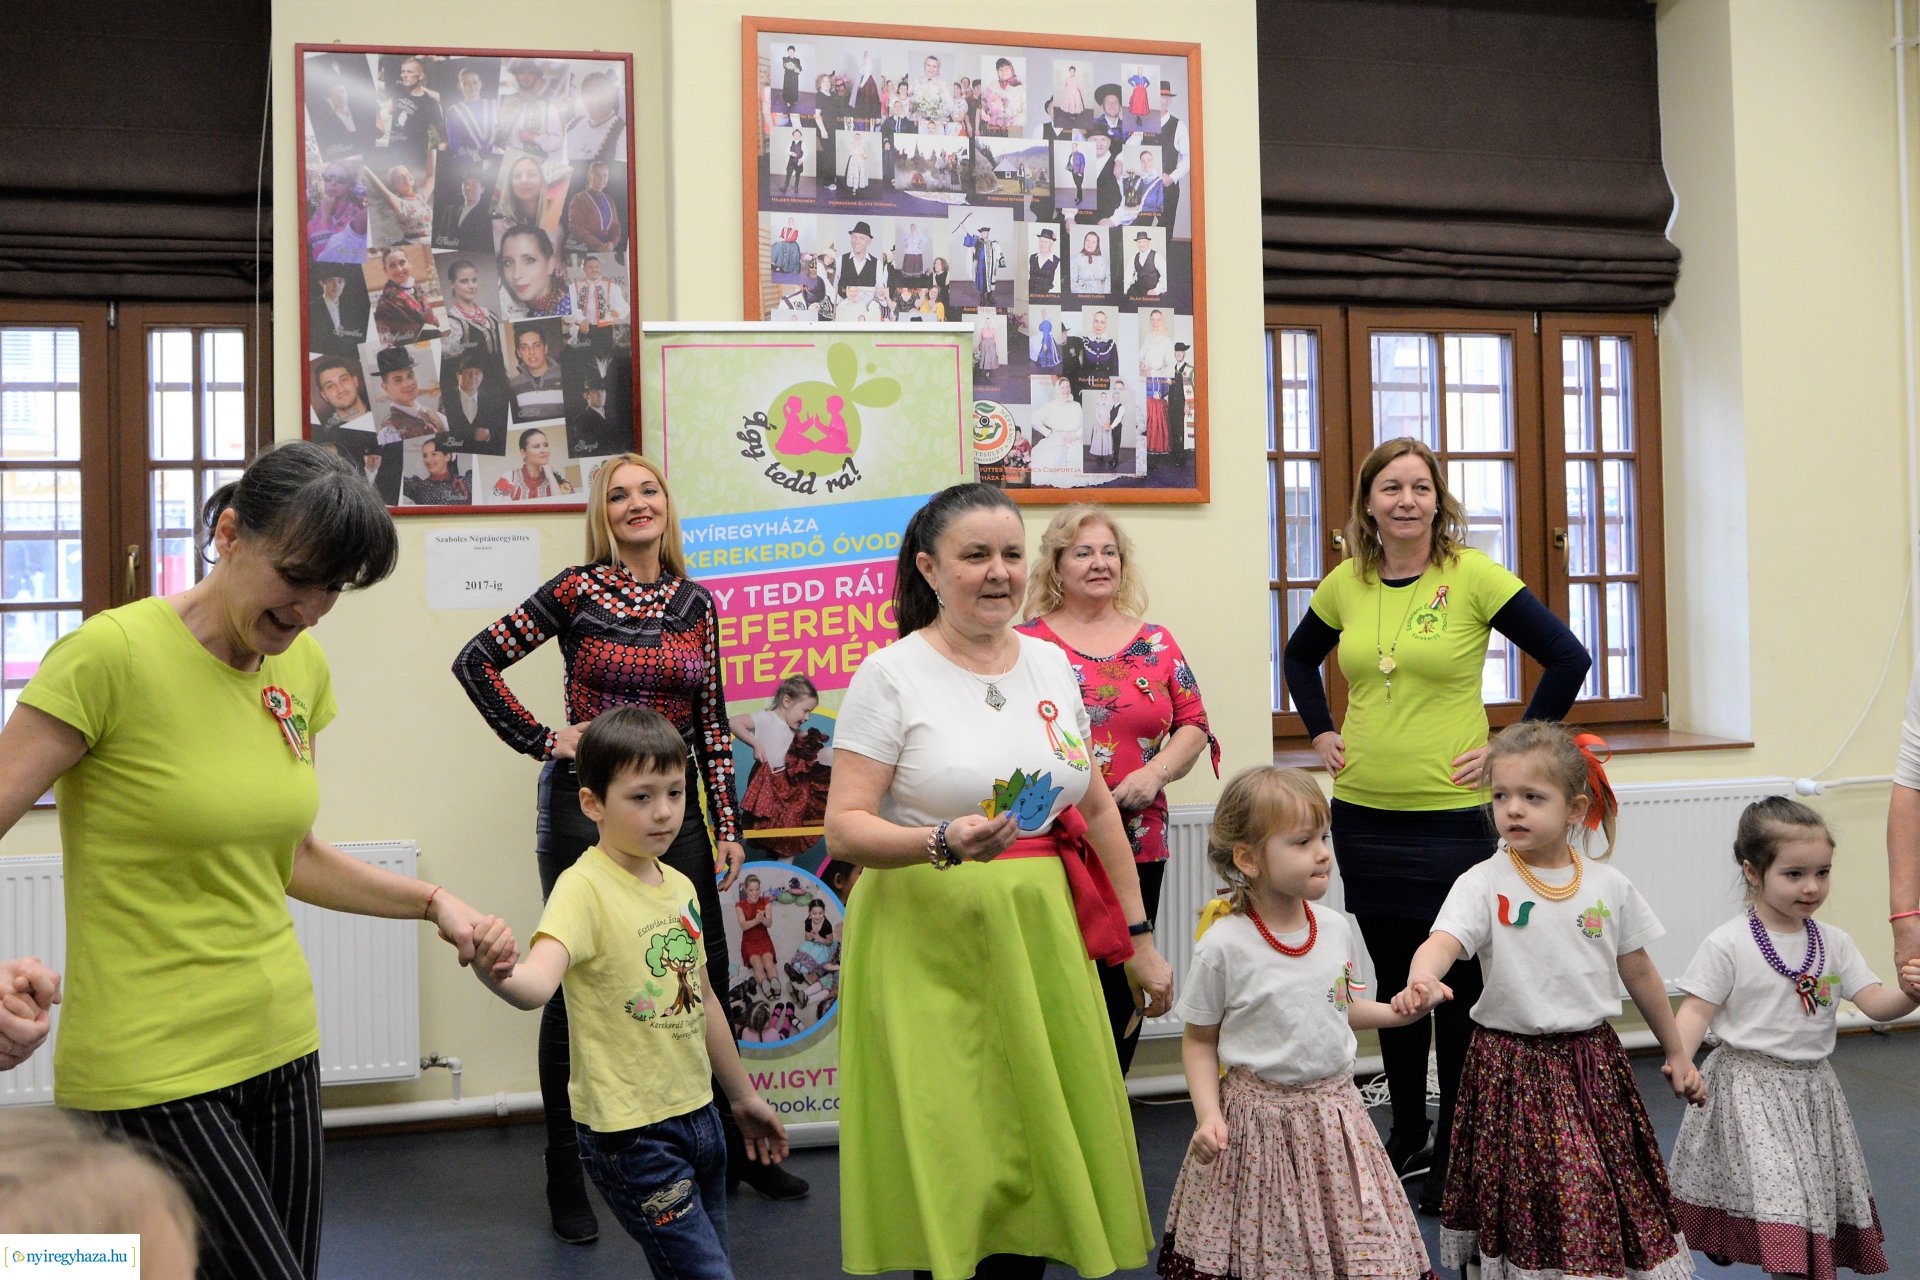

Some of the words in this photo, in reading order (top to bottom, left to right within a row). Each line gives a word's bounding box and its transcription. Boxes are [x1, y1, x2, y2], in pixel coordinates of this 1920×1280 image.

[736, 411, 777, 462] Így
[764, 462, 818, 495] tedd
[825, 456, 862, 493] rá!
[681, 517, 819, 544] NYÍREGYHÁZA
[683, 534, 826, 569] KEREKERDŐ
[832, 532, 901, 555] ÓVOD
[465, 580, 504, 591] 2017-ig
[743, 579, 825, 608] TEDD
[835, 567, 884, 599] RÁ!
[718, 598, 900, 648] EFERENC
